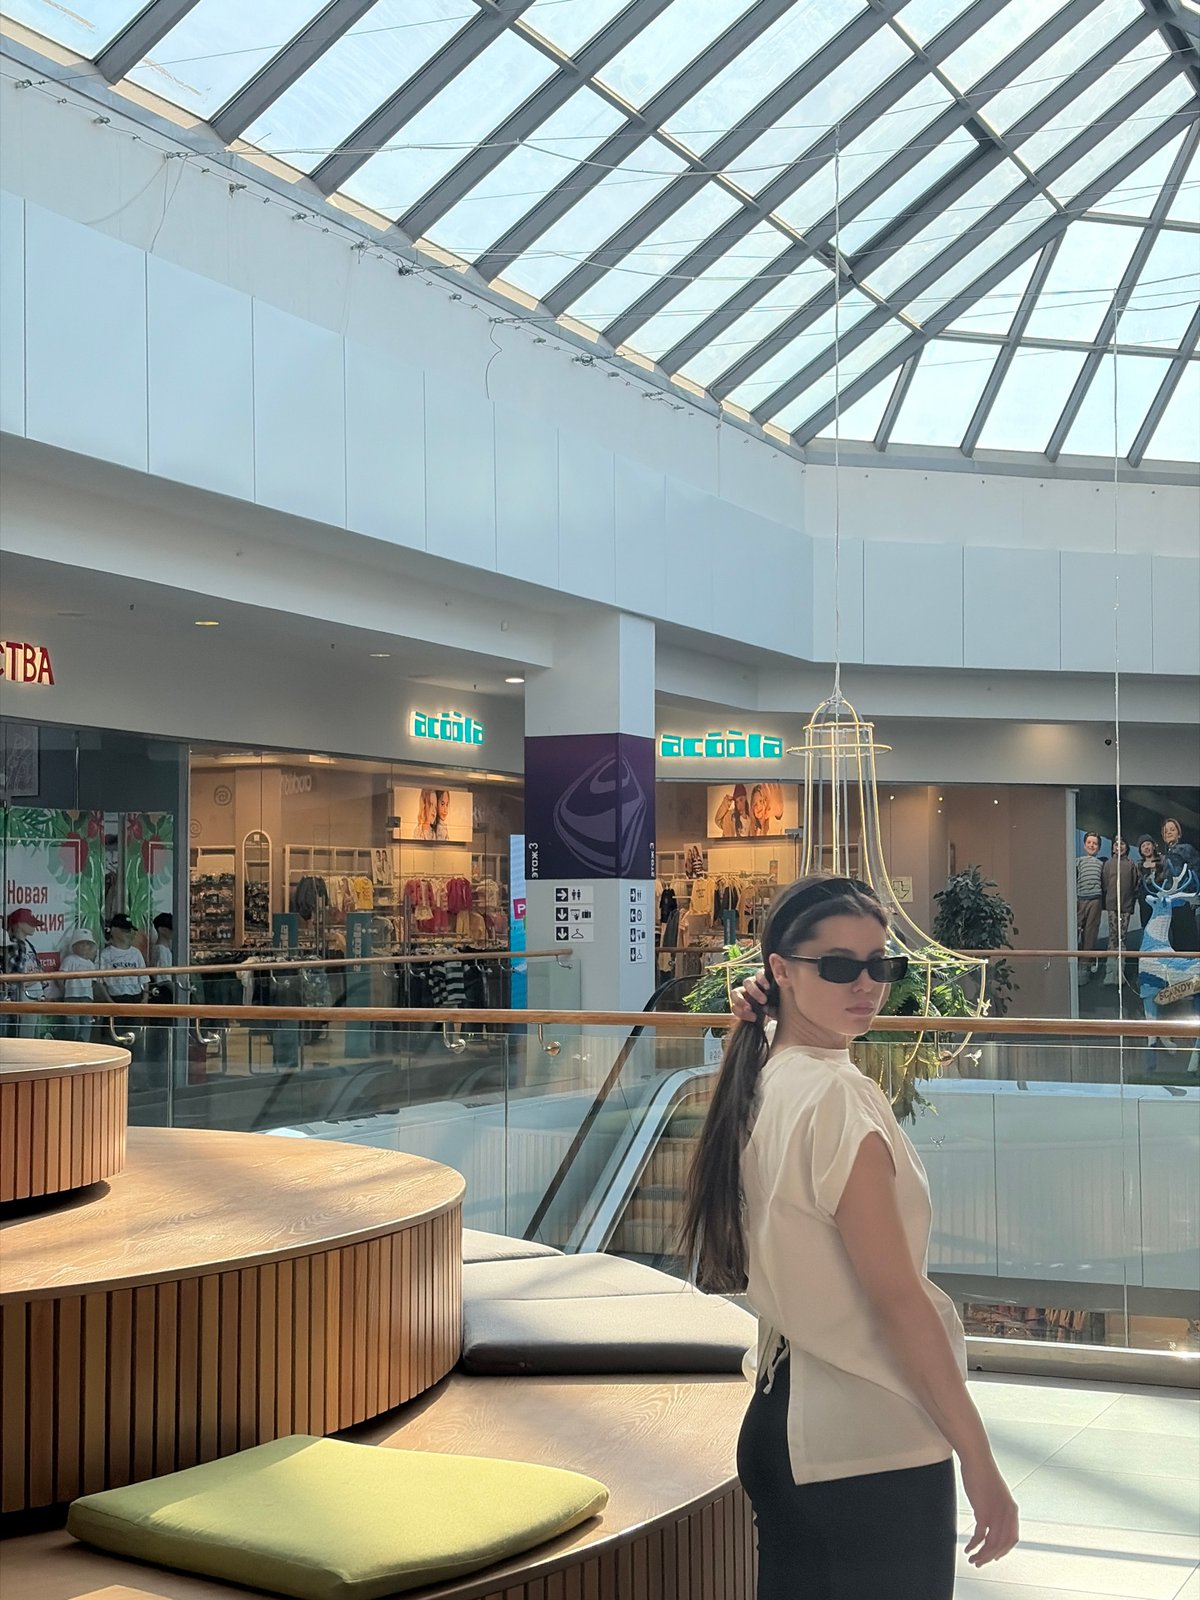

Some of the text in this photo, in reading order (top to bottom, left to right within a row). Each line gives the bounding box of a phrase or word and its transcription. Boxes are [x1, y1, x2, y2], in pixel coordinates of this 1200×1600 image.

[528, 842, 539, 879] этаж 3
[7, 879, 48, 904] Новая
